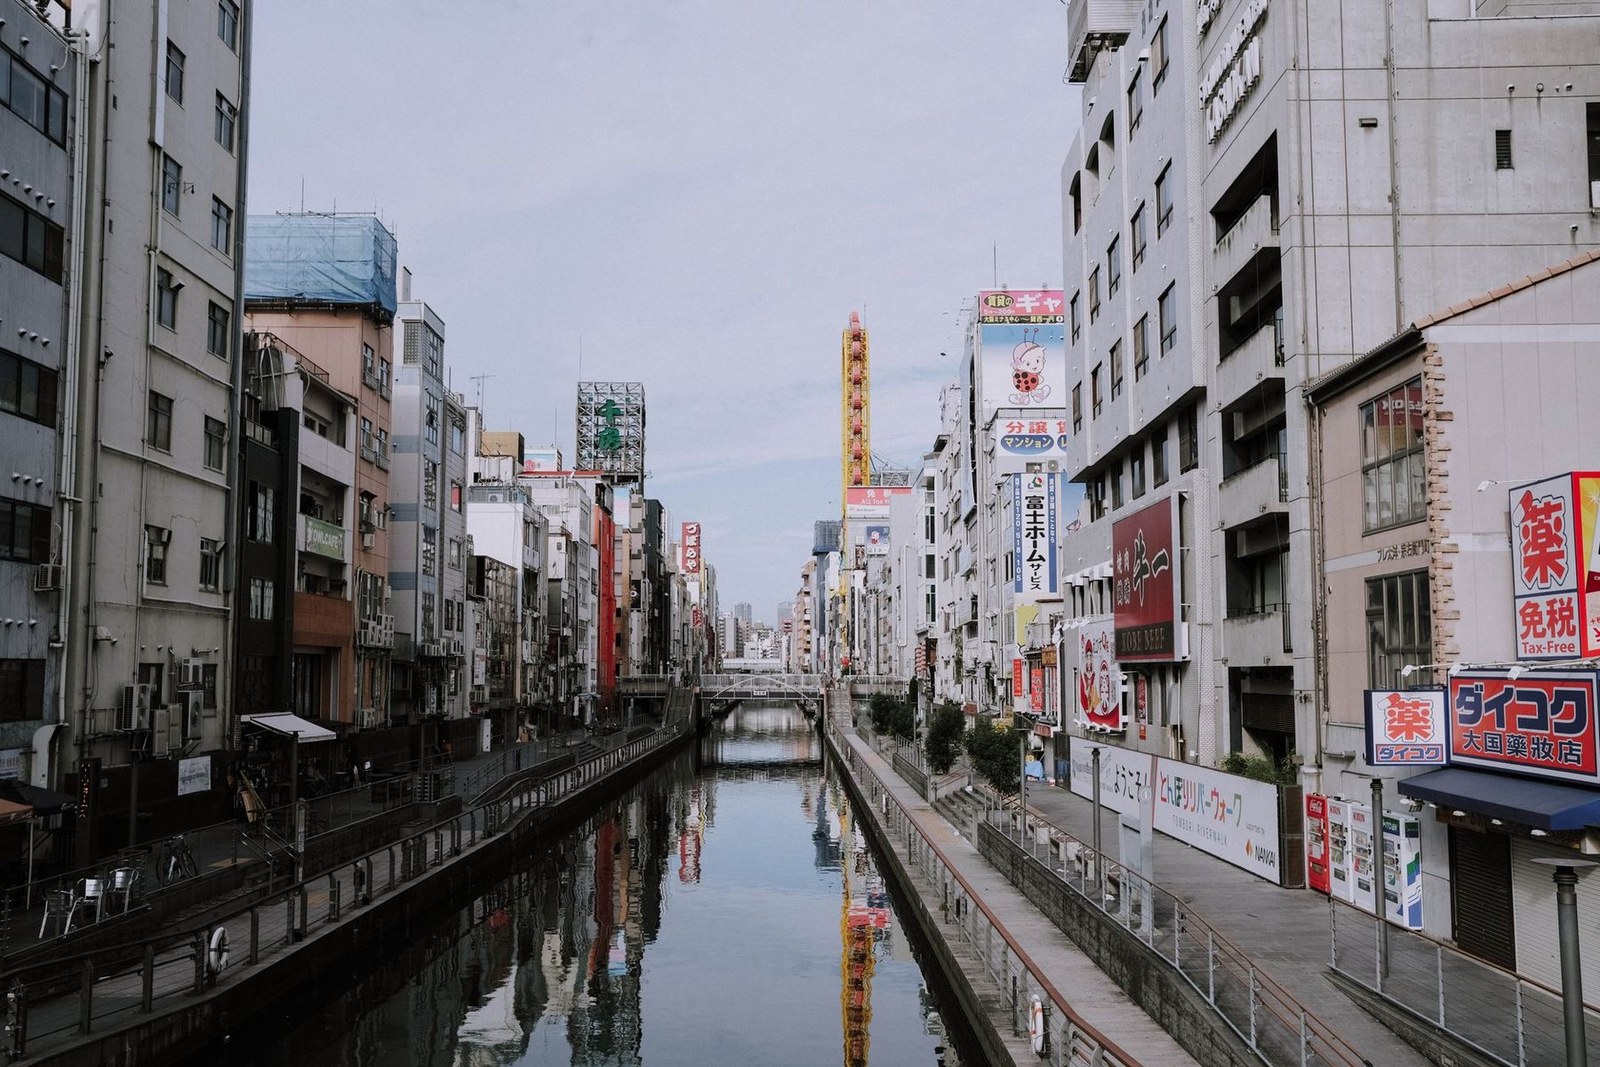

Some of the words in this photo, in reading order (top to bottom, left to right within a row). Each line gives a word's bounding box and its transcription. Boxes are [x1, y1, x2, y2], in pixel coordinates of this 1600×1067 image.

[1004, 437, 1051, 448] マンション
[1006, 421, 1048, 434] 分譲
[1025, 495, 1046, 590] 富士ホームサービス
[1520, 501, 1565, 584] 薬
[1519, 597, 1576, 640] 免税
[1522, 641, 1575, 654] Tax-Free
[1387, 699, 1432, 741] 薬
[1456, 683, 1588, 737] ダイコク
[1379, 747, 1440, 760] ダイコク
[1255, 845, 1276, 868] NANKAI
